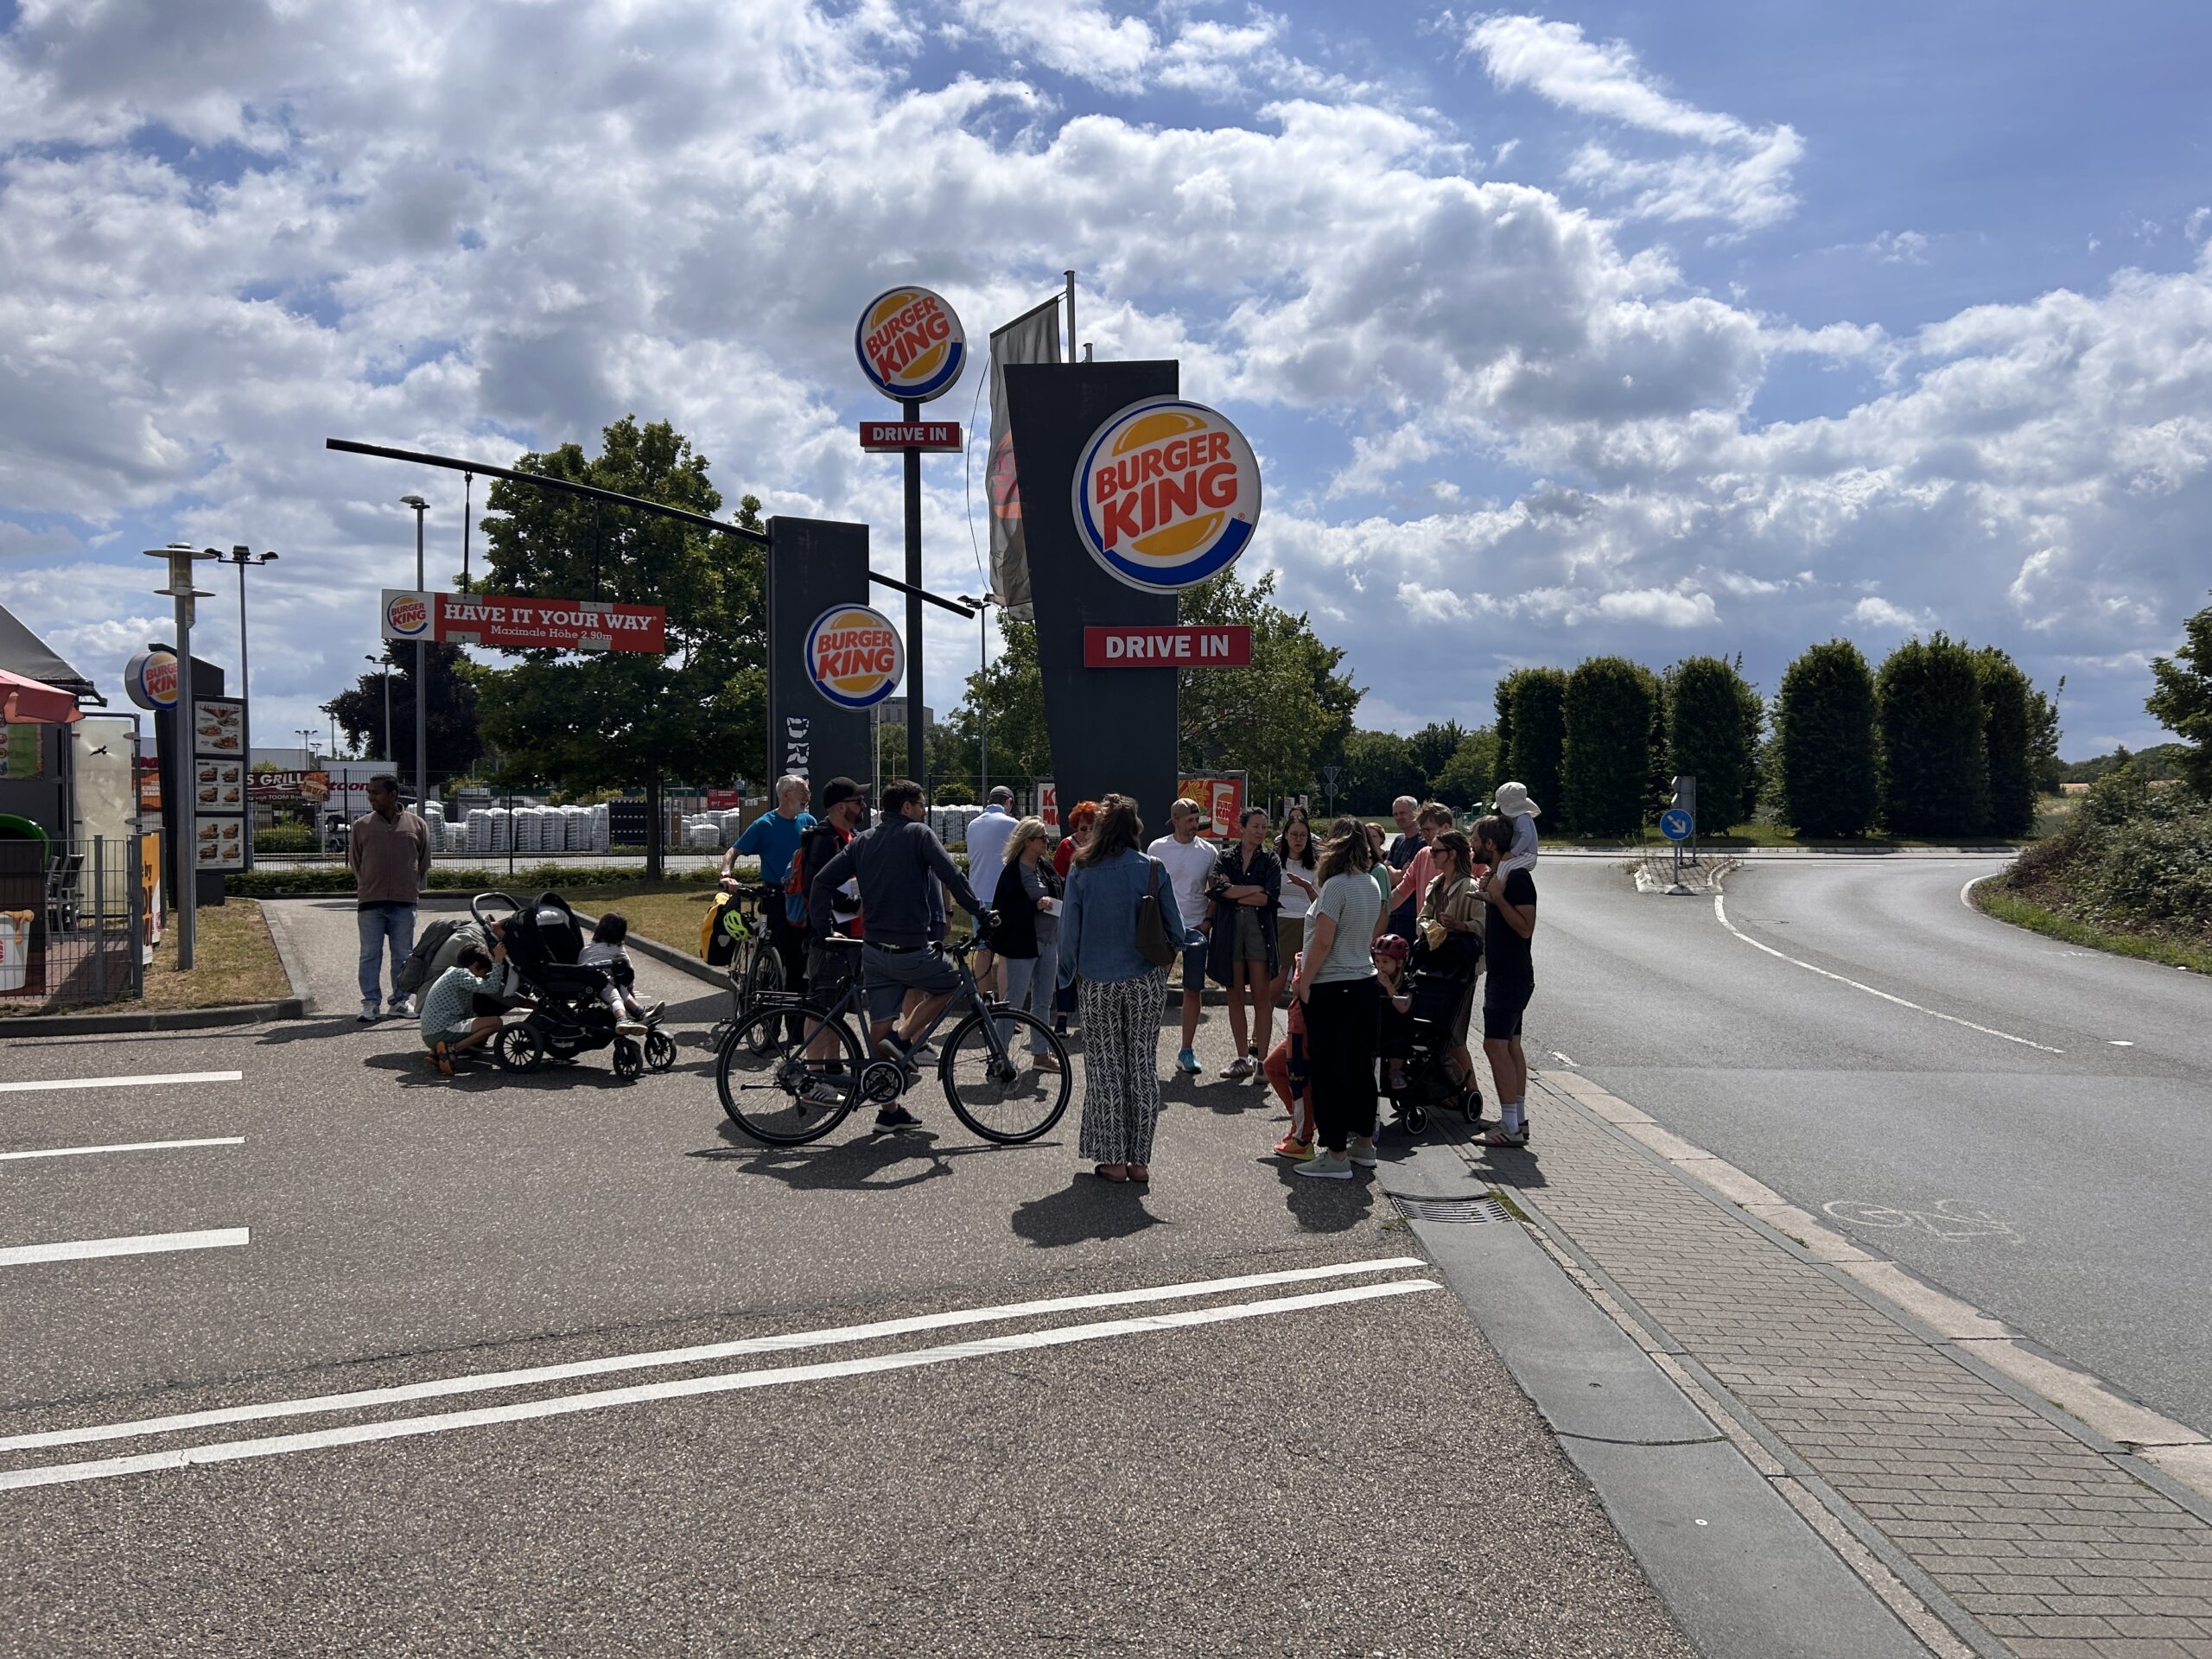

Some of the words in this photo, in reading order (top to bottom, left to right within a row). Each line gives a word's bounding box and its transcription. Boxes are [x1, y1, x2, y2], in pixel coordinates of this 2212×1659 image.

[866, 296, 939, 360] BURGER
[876, 311, 950, 385] KING
[872, 427, 925, 442] DRIVE
[929, 427, 947, 442] IN
[1096, 431, 1231, 505] BURGER
[1102, 461, 1238, 551] KING
[391, 602, 425, 617] BURGER
[392, 609, 427, 626] KING
[444, 603, 506, 623] HAVE
[512, 607, 533, 624] IT
[538, 609, 600, 628] YOUR
[490, 625, 547, 638] Maximale
[549, 628, 579, 640] Höhe
[581, 630, 613, 641] 2.90m
[817, 630, 893, 654] BURGER
[1106, 635, 1192, 658] DRIVE
[1200, 634, 1230, 658] IN
[145, 662, 178, 681] BURGE
[817, 647, 895, 681] KING
[147, 674, 178, 696] KIN
[785, 716, 810, 797] DRI
[260, 772, 305, 786] GRILL
